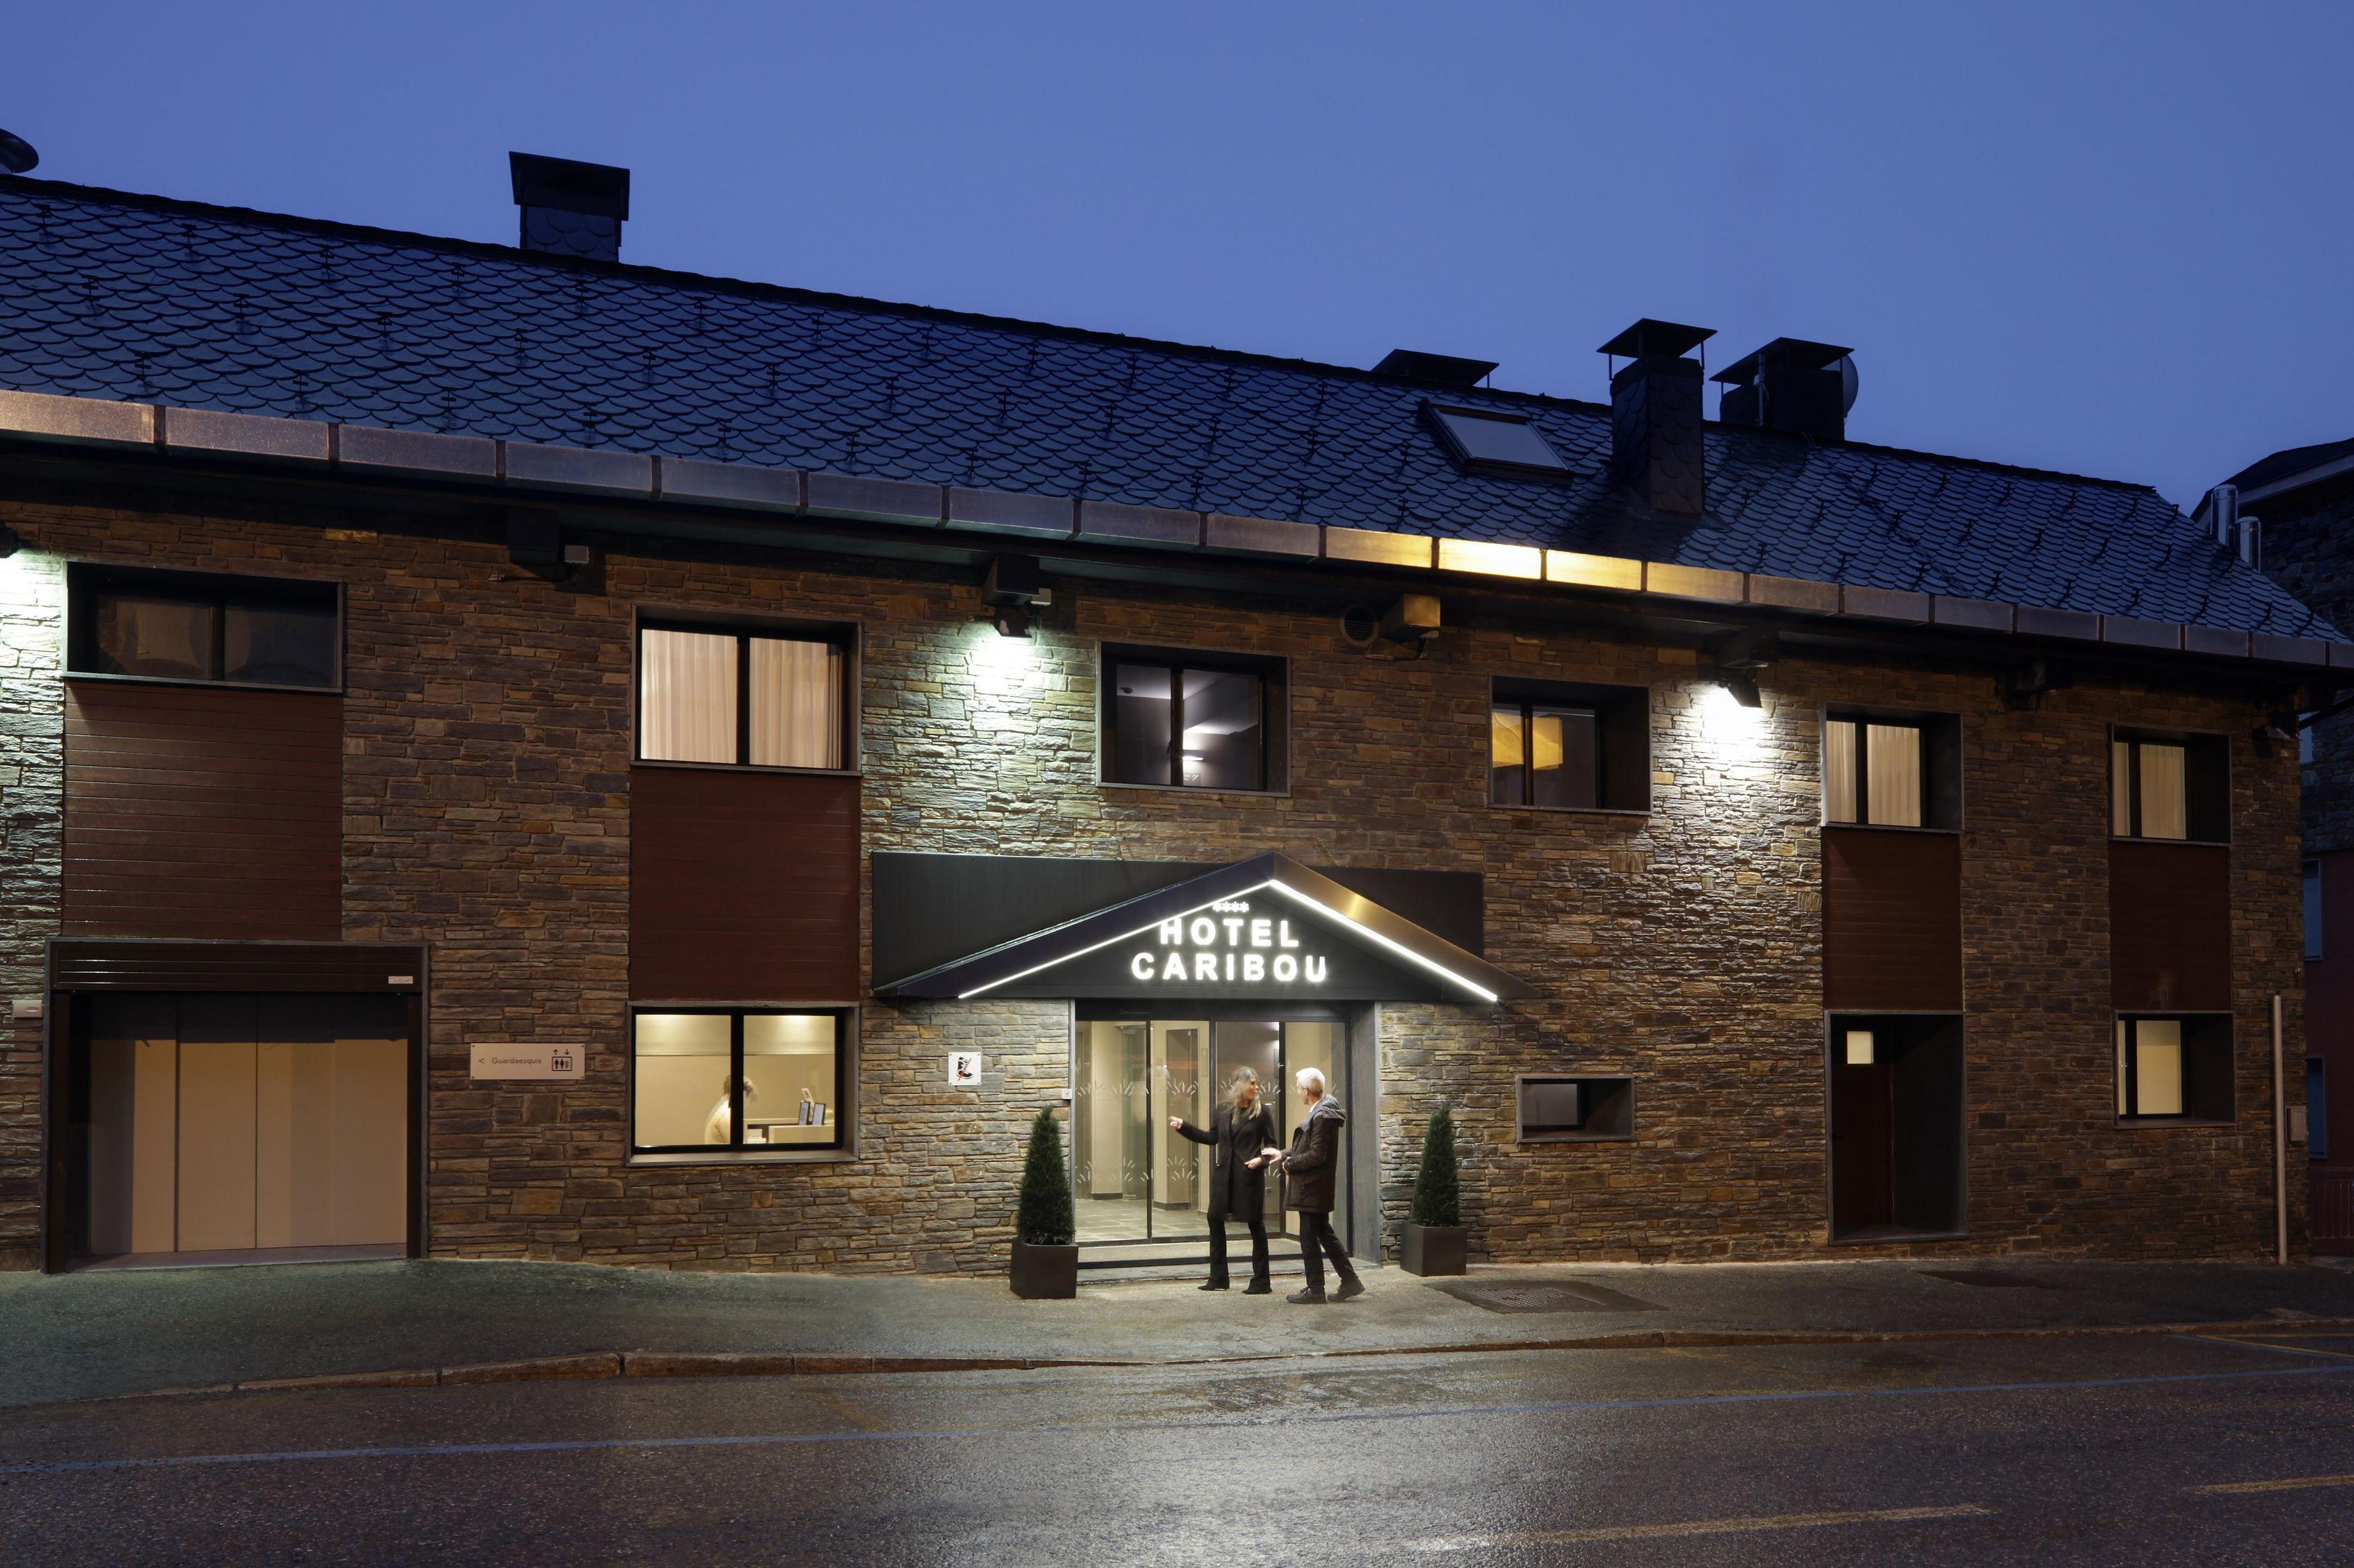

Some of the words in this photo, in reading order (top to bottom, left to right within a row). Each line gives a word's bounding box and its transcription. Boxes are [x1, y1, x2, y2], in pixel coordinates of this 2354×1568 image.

[1159, 917, 1299, 947] HOTEL
[1131, 952, 1327, 982] CARIBOU
[491, 1056, 542, 1065] Guardaesquis
